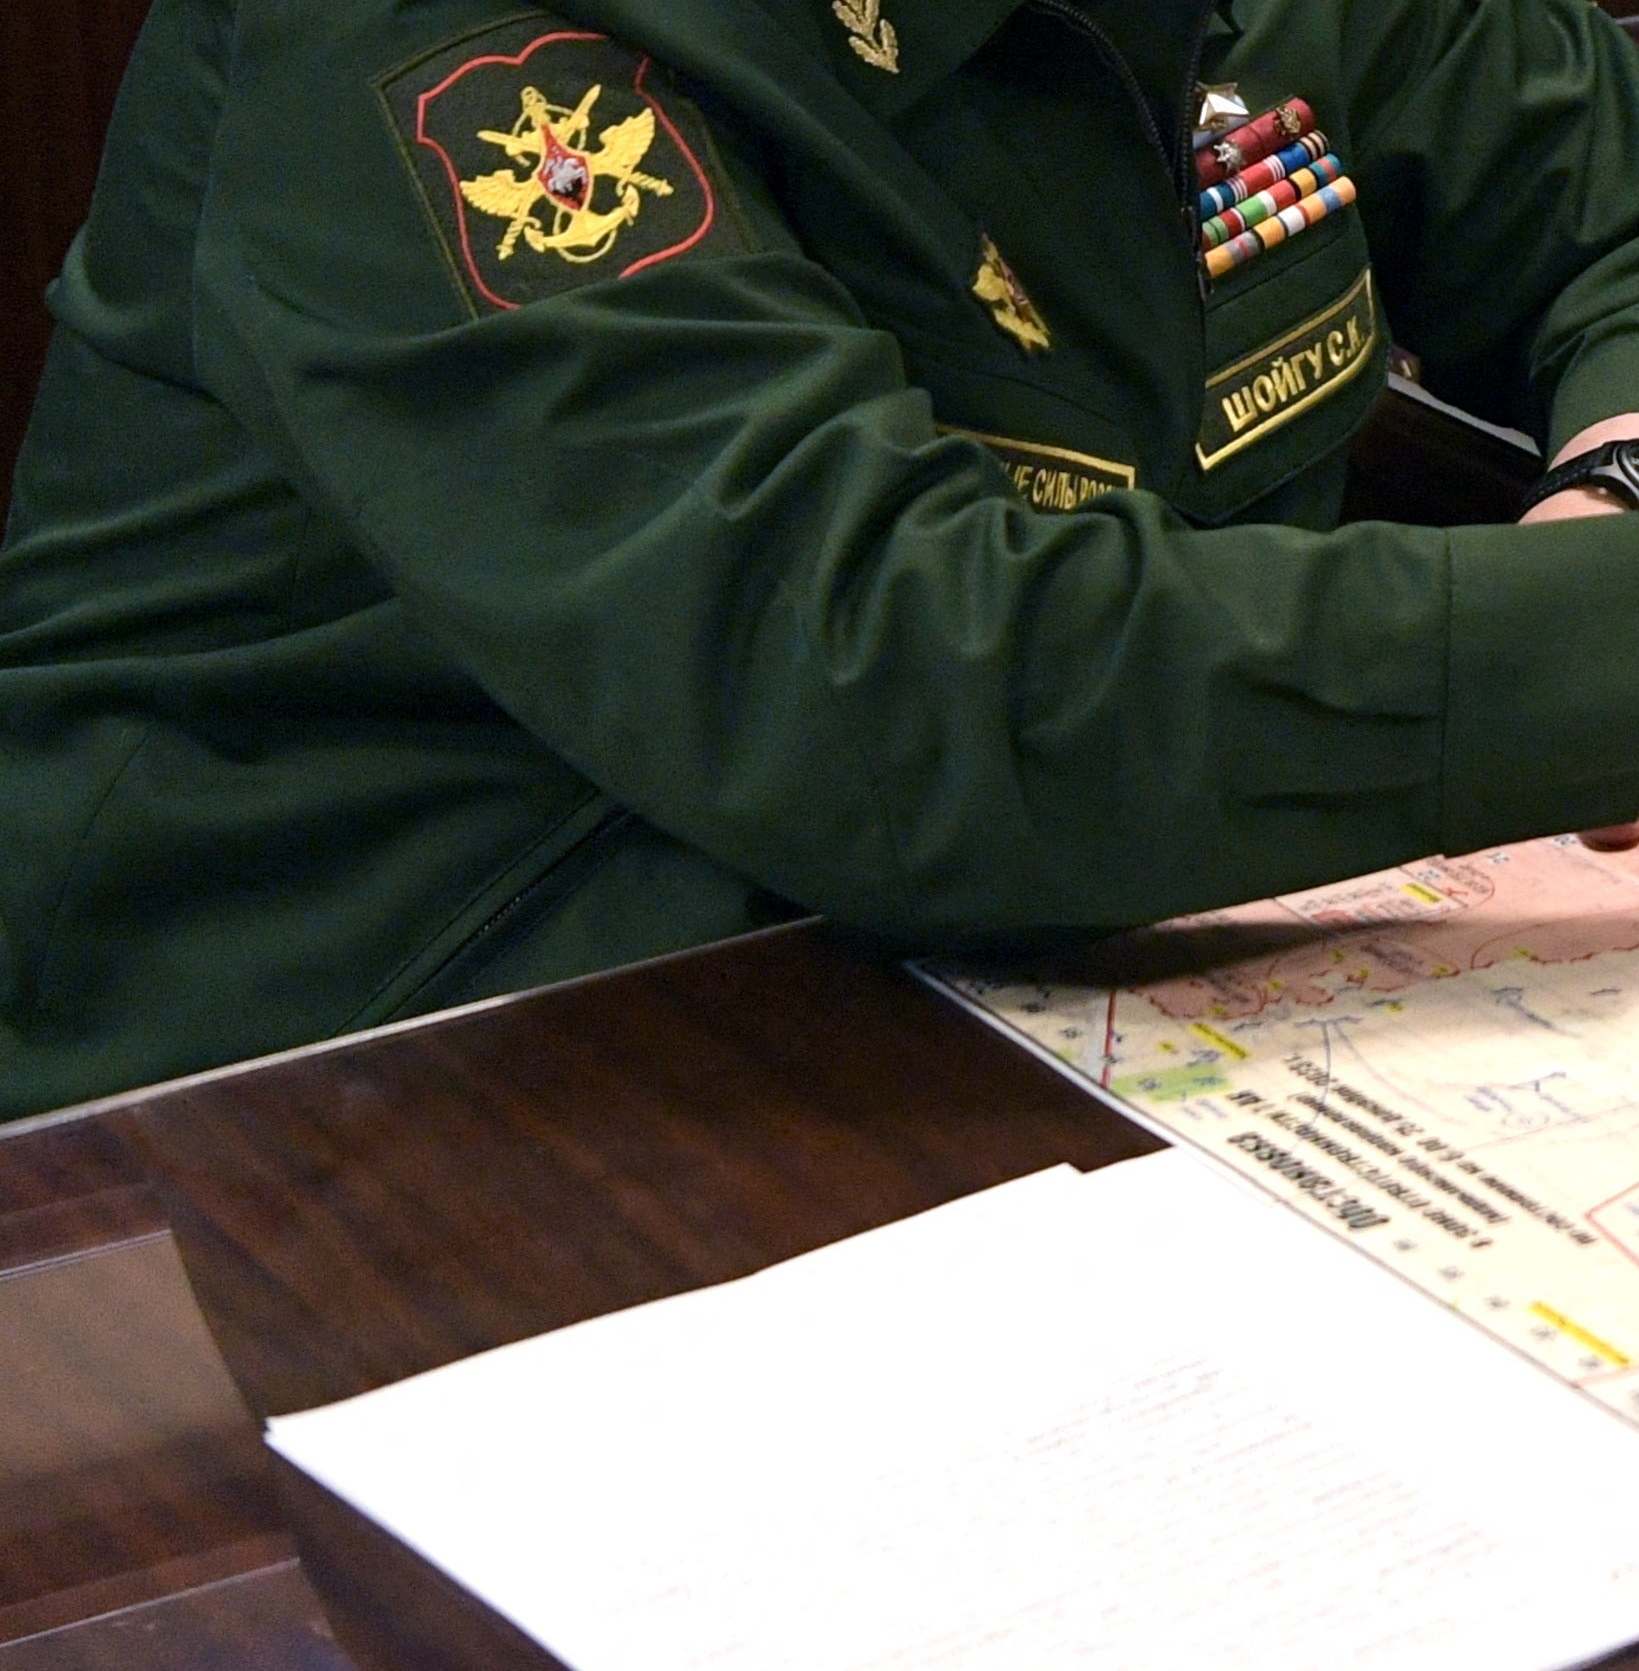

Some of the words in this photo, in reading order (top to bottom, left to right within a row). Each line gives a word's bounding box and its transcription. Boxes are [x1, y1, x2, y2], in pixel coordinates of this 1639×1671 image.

[1220, 342, 1324, 433] ШОЙГУ
[1326, 315, 1367, 367] С.К.
[1032, 467, 1079, 510] СИЛЫ
[1226, 1130, 1390, 1230] Обстановка
[1266, 1109, 1432, 1208] ответственности
[1420, 1207, 1477, 1238] зоне
